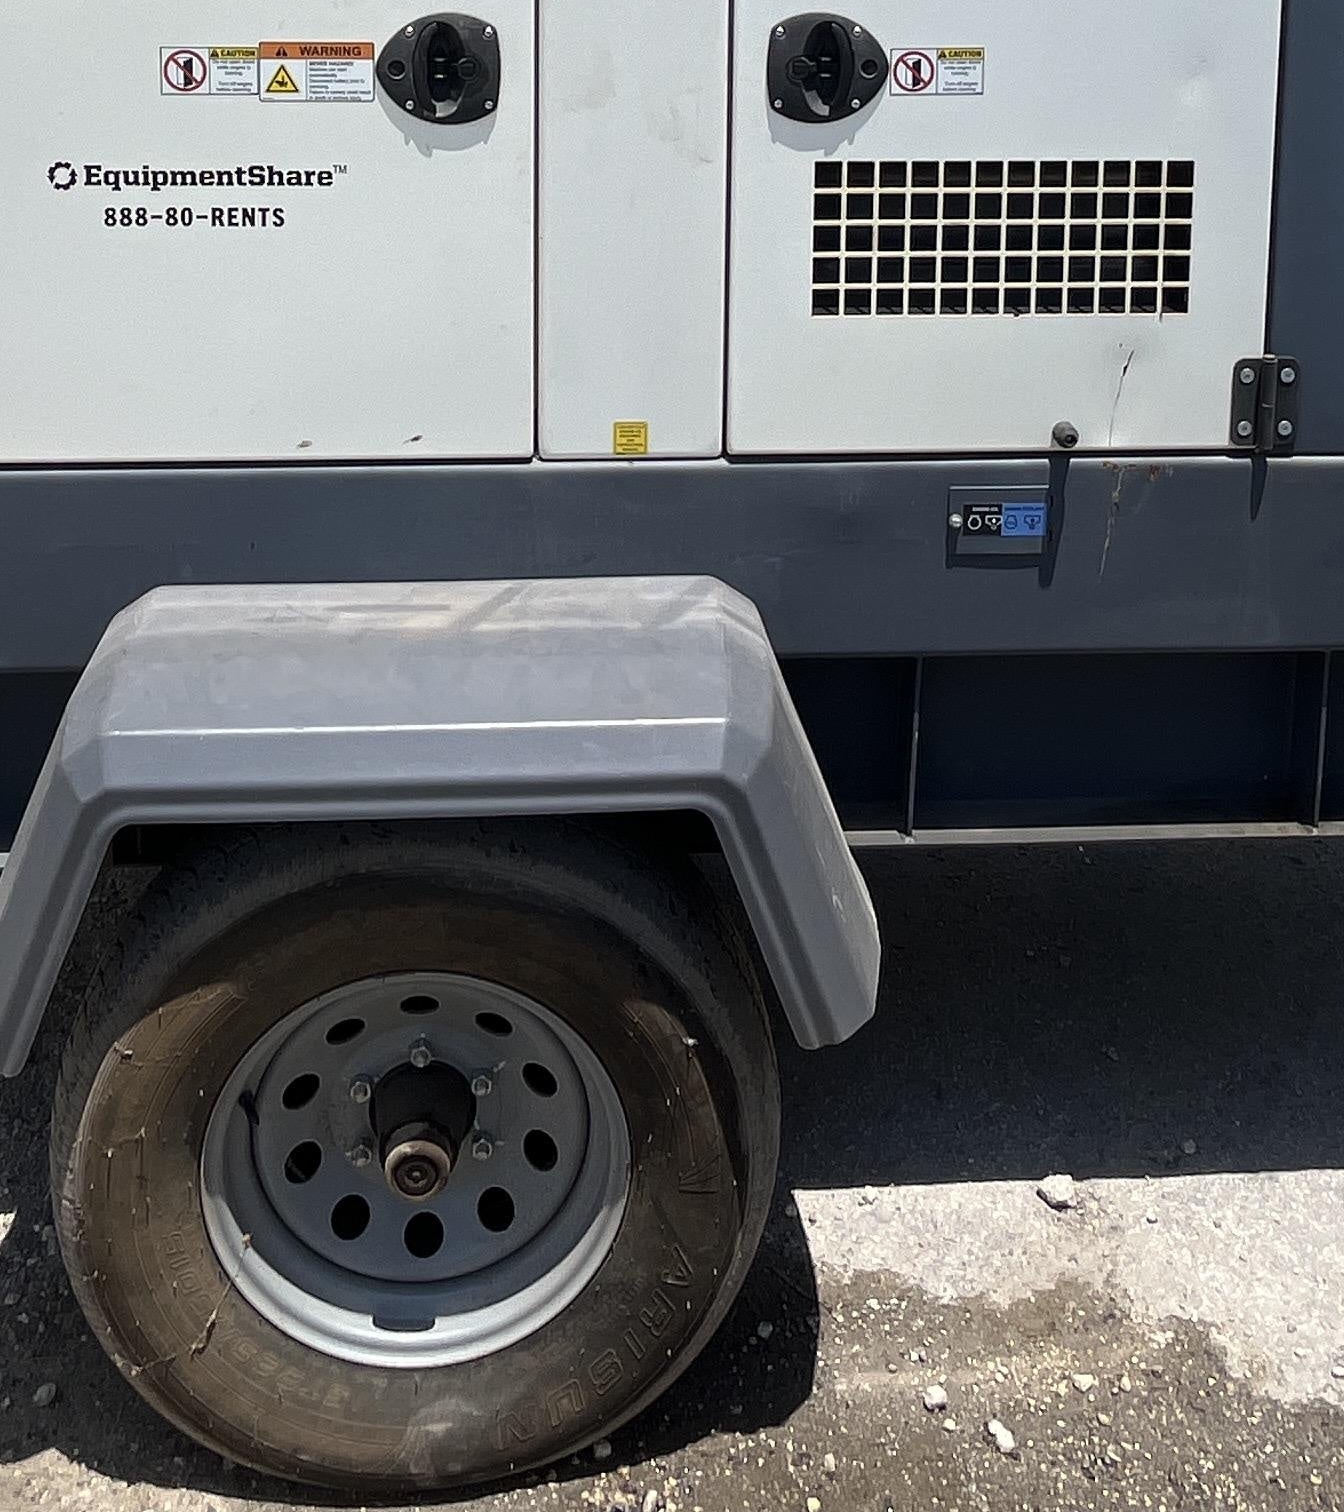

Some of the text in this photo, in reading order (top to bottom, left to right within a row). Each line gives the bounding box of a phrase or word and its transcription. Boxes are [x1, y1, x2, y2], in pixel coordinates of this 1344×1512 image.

[298, 45, 363, 57] WARNING
[83, 164, 334, 191] EquipmentShare
[103, 207, 286, 228] 888-80-RENTS
